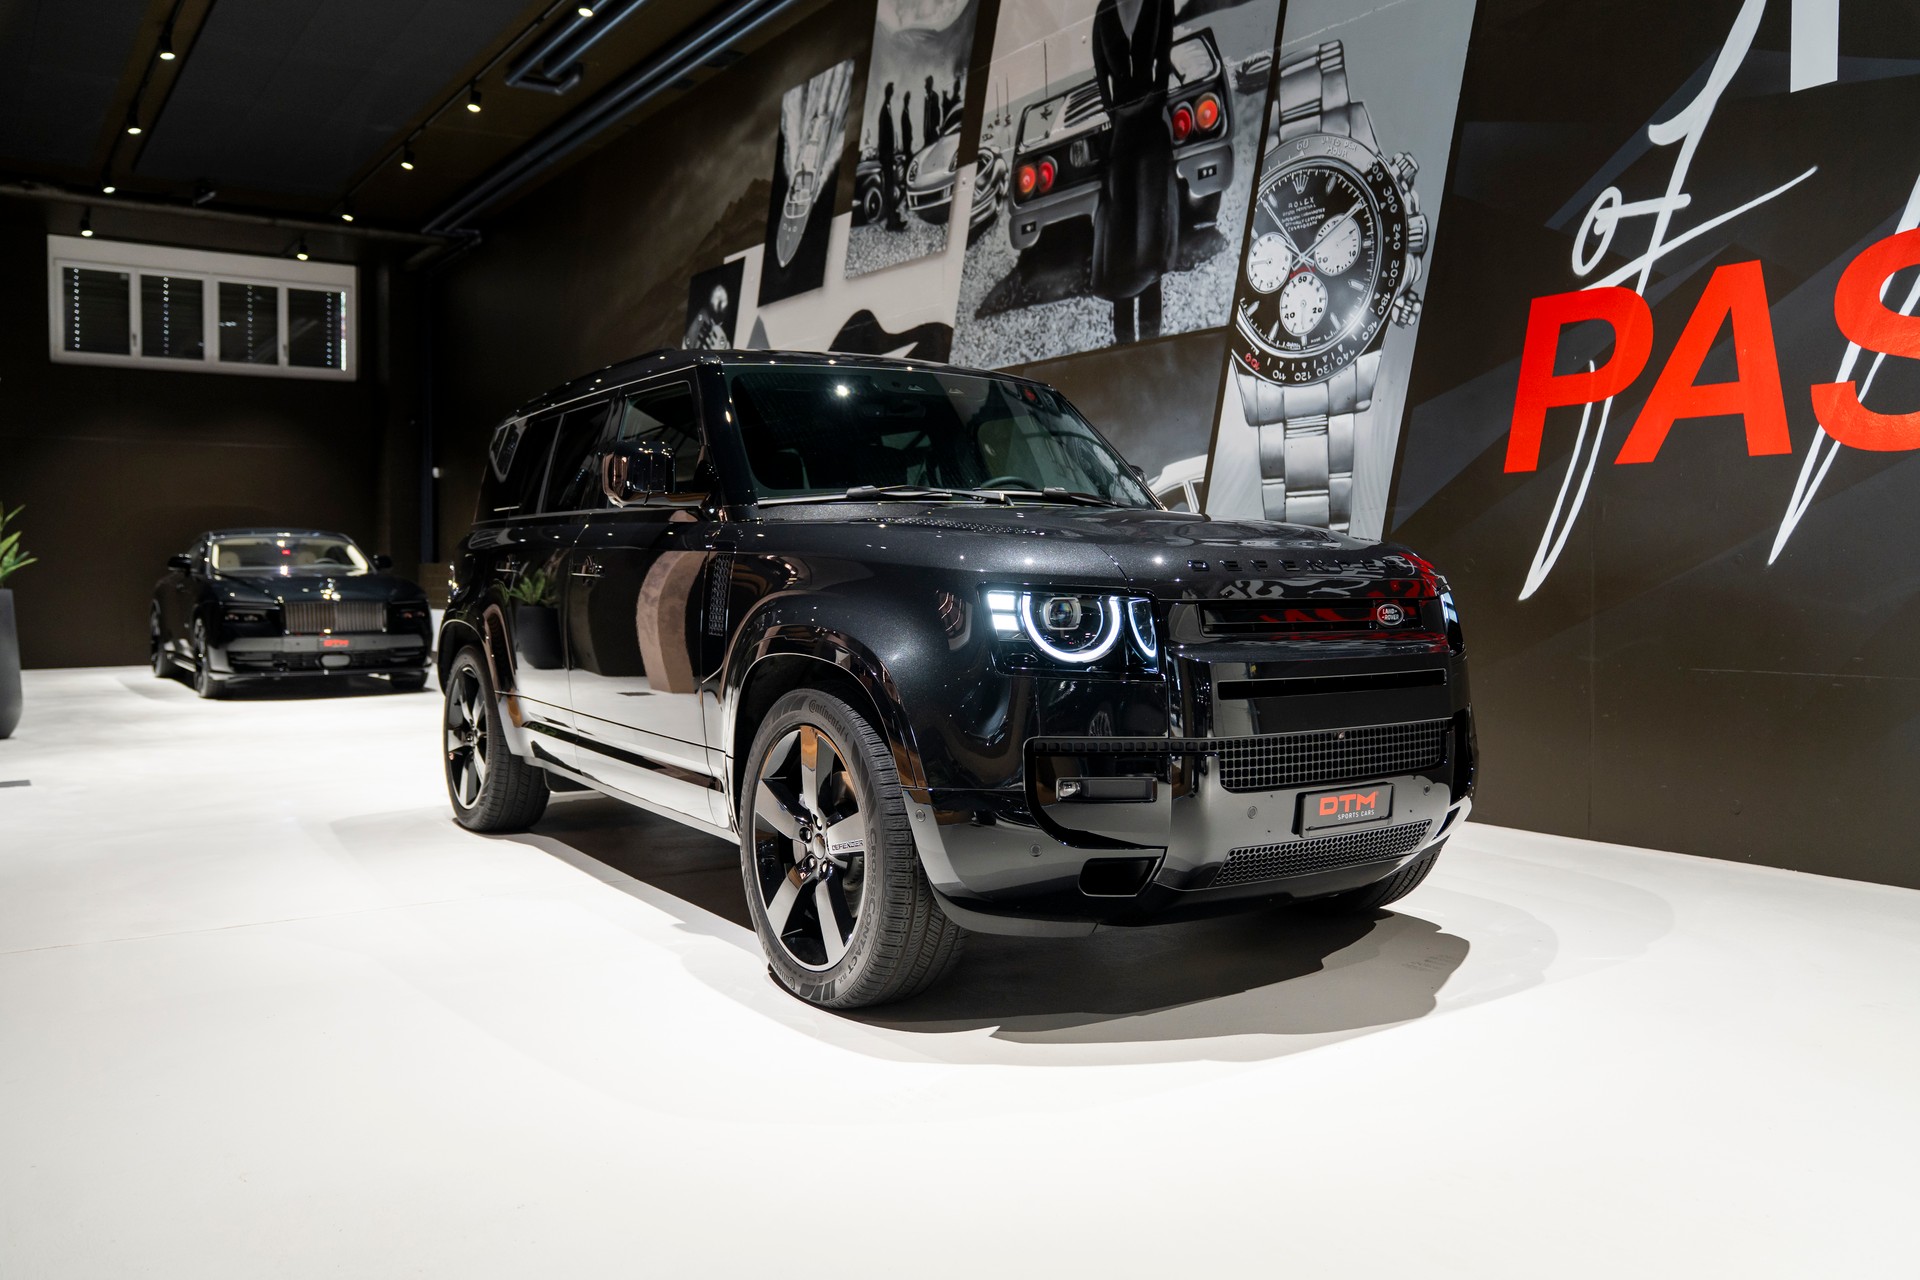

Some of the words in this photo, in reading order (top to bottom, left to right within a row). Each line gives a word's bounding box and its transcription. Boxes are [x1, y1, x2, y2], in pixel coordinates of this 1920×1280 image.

[1383, 186, 1398, 213] 300
[1392, 223, 1401, 250] 240
[1388, 260, 1400, 287] 200
[1377, 292, 1391, 315] 180
[1284, 312, 1296, 320] 40
[1362, 321, 1377, 341] 160
[1504, 227, 1920, 474] PAS
[1294, 370, 1312, 382] 120
[1319, 791, 1377, 816] DTM
[1337, 811, 1360, 821] SPORTS
[1361, 809, 1375, 817] CARS
[831, 839, 864, 851] DEFENDER
